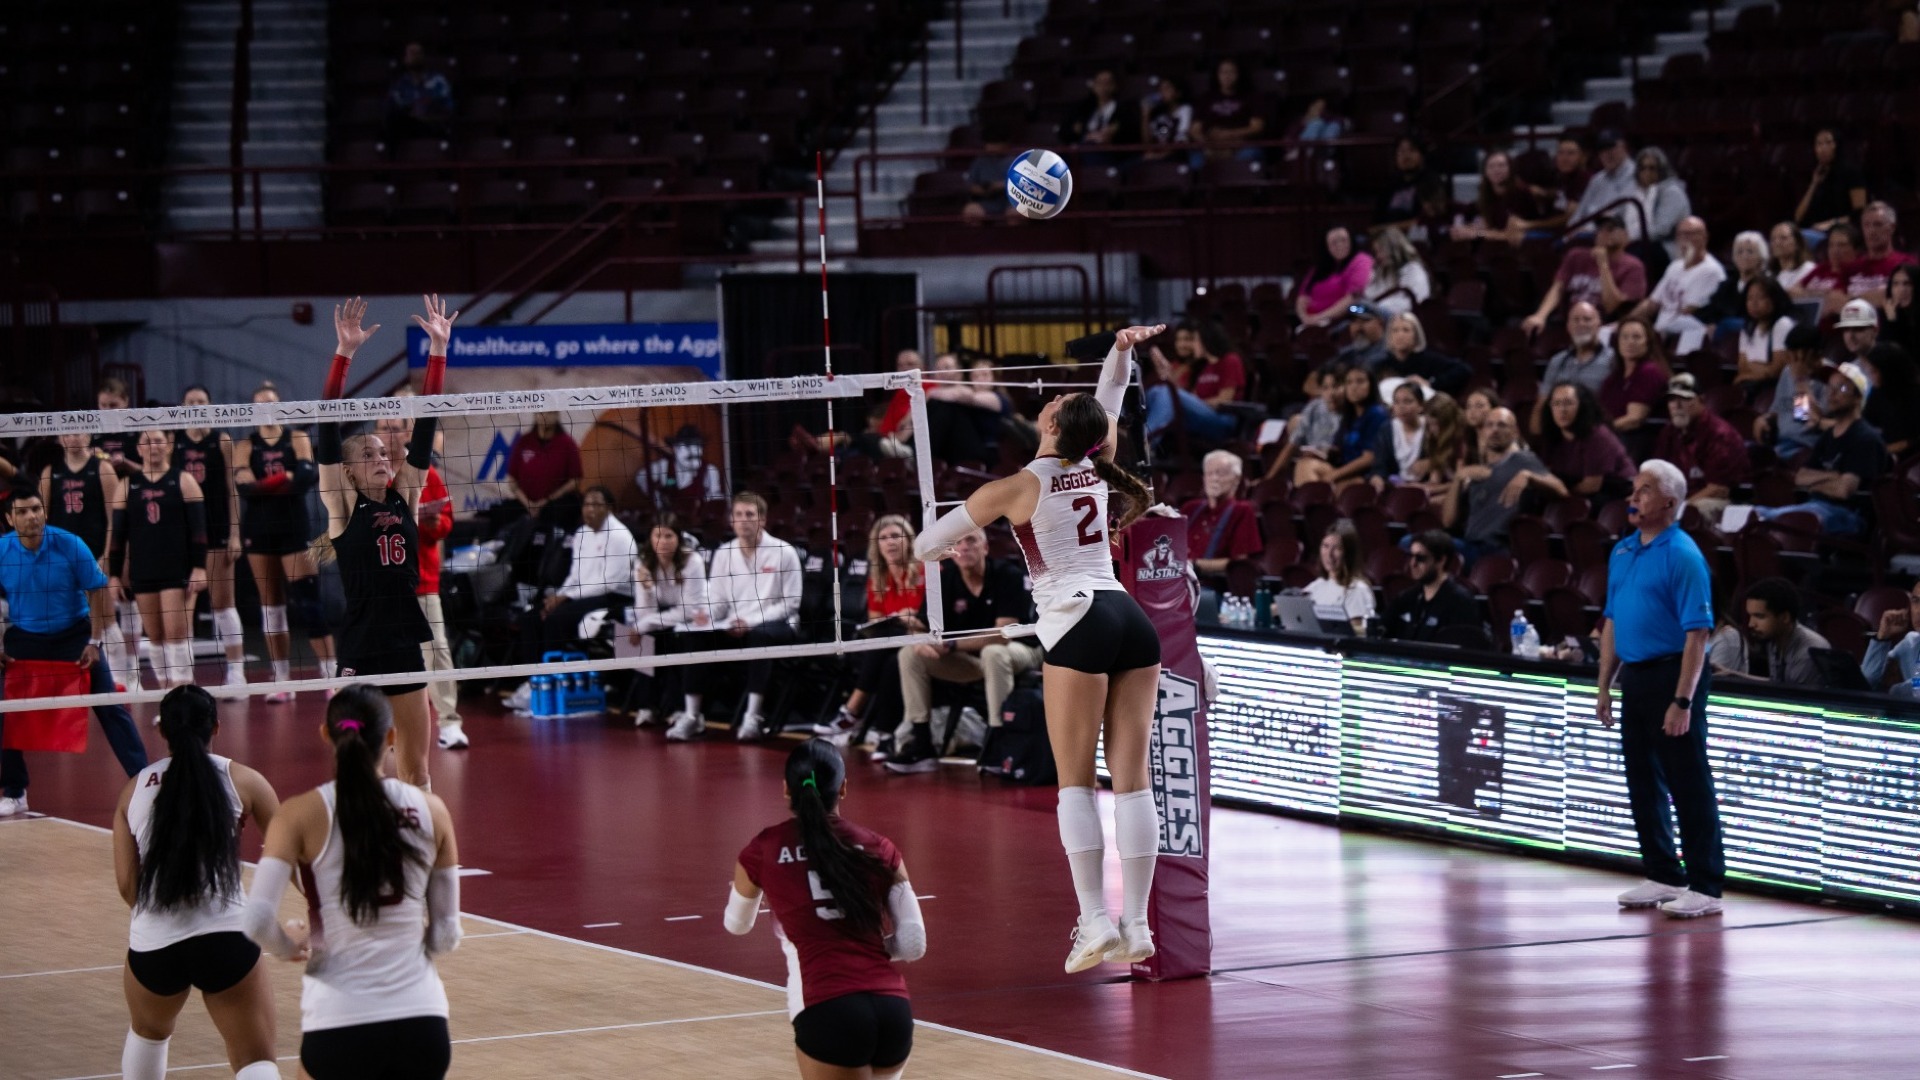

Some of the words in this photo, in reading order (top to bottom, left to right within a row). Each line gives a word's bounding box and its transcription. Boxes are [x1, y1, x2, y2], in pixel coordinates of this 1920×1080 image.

[1011, 186, 1043, 210] molten
[453, 336, 550, 357] healthcare,
[554, 340, 581, 360] go
[583, 334, 640, 355] where
[643, 334, 675, 354] the
[609, 388, 644, 398] WHITE
[651, 386, 687, 396] SANDS
[747, 381, 783, 391] WHITE
[318, 402, 356, 412] WHITE
[363, 400, 401, 410] SANDS
[464, 395, 501, 404] WHITE
[508, 393, 545, 404] SANDS
[12, 415, 53, 426] WHITE
[168, 409, 208, 418] WHITE
[215, 407, 254, 417] SANDS
[1050, 468, 1101, 492] AGGIES
[1072, 496, 1103, 546] 2
[376, 533, 406, 566] 16
[1137, 569, 1154, 580] NM
[1159, 671, 1199, 854] AGGIES
[1155, 792, 1168, 850] STATE
